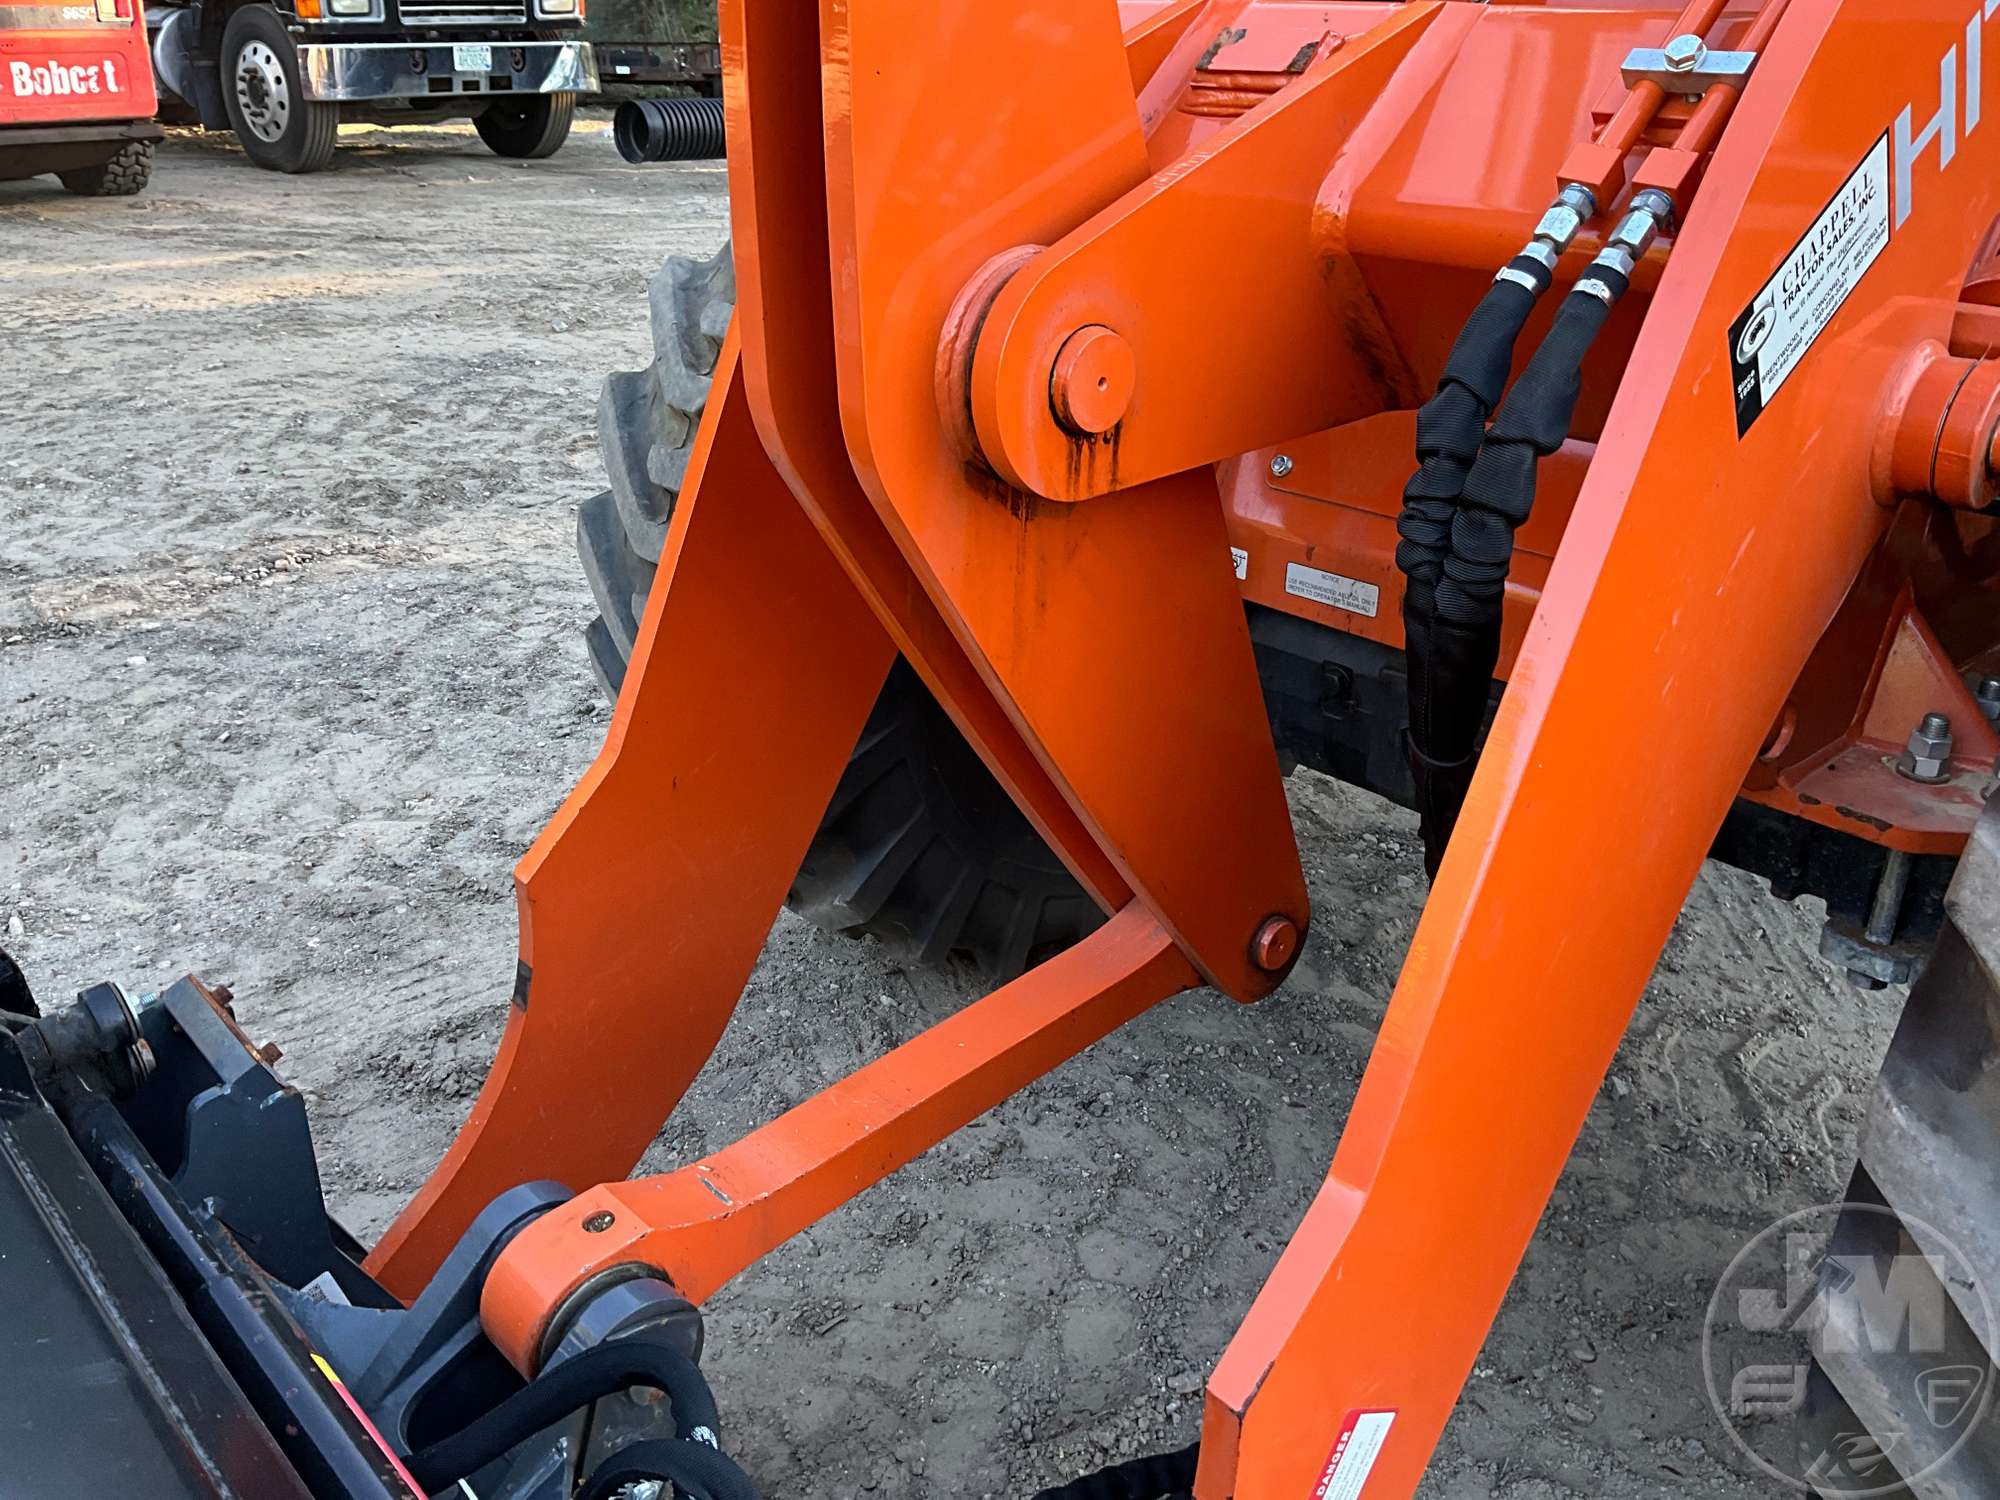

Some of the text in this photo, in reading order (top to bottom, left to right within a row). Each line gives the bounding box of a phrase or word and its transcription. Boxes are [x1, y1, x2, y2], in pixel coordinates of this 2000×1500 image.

[9, 60, 119, 97] Bobcat
[1895, 0, 2000, 231] HI
[1783, 171, 1872, 293] CHAPPELL
[1783, 186, 1877, 310] TRACTOR SALES, INC.
[1316, 1431, 1351, 1496] DANGER
